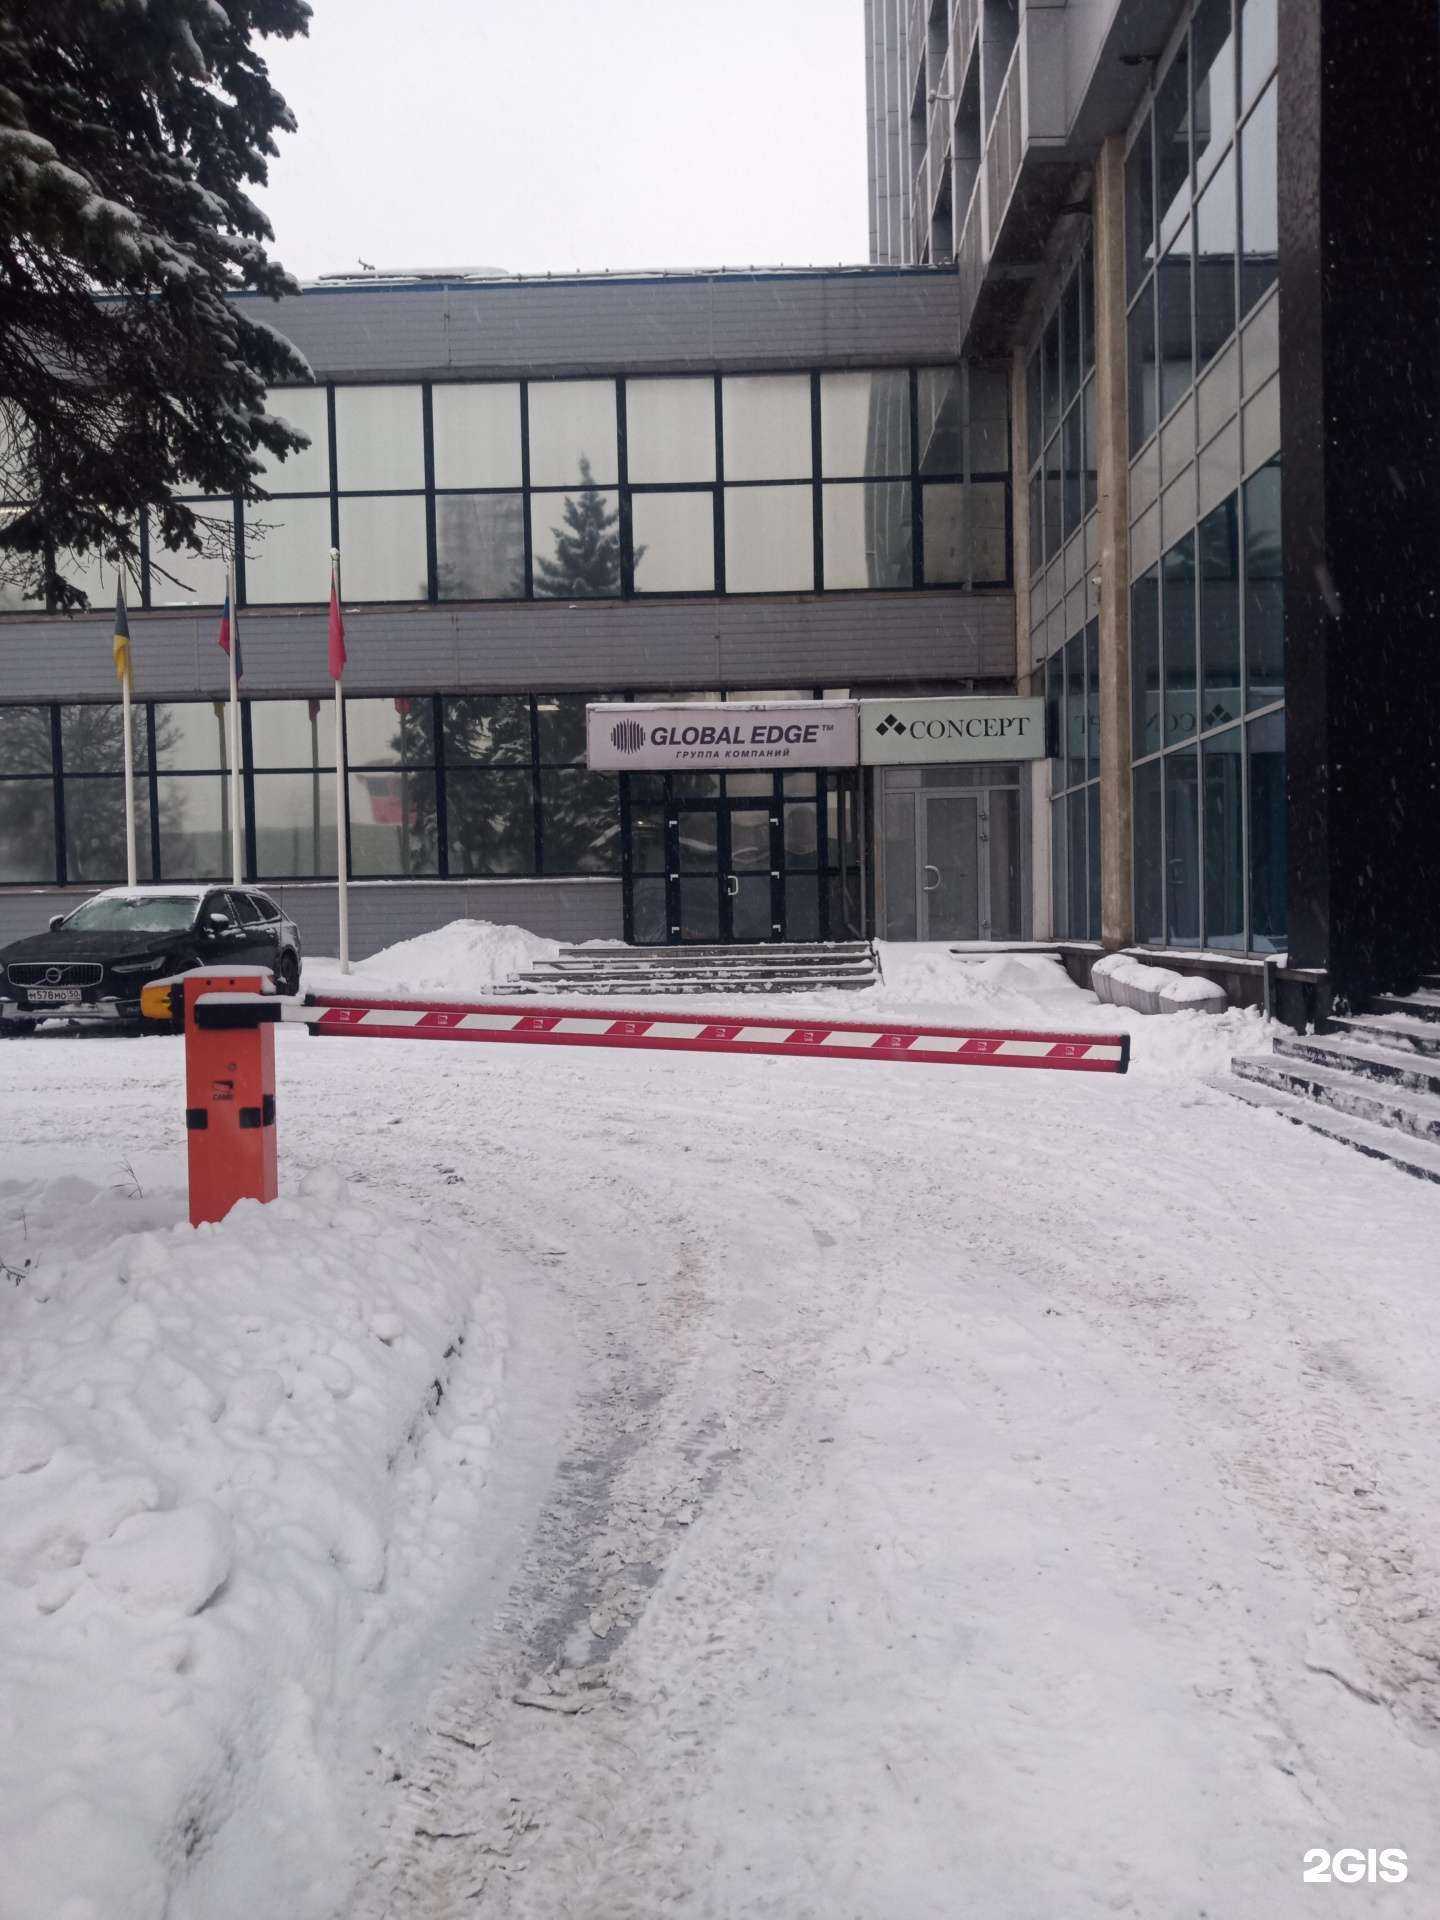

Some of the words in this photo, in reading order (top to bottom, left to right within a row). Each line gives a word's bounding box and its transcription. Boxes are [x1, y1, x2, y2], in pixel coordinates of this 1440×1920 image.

[650, 726, 746, 745] GLOBAL
[910, 717, 1030, 739] CONCEPT
[676, 750, 720, 759] ГРУППА
[724, 748, 790, 758] КОМПАНИЙ
